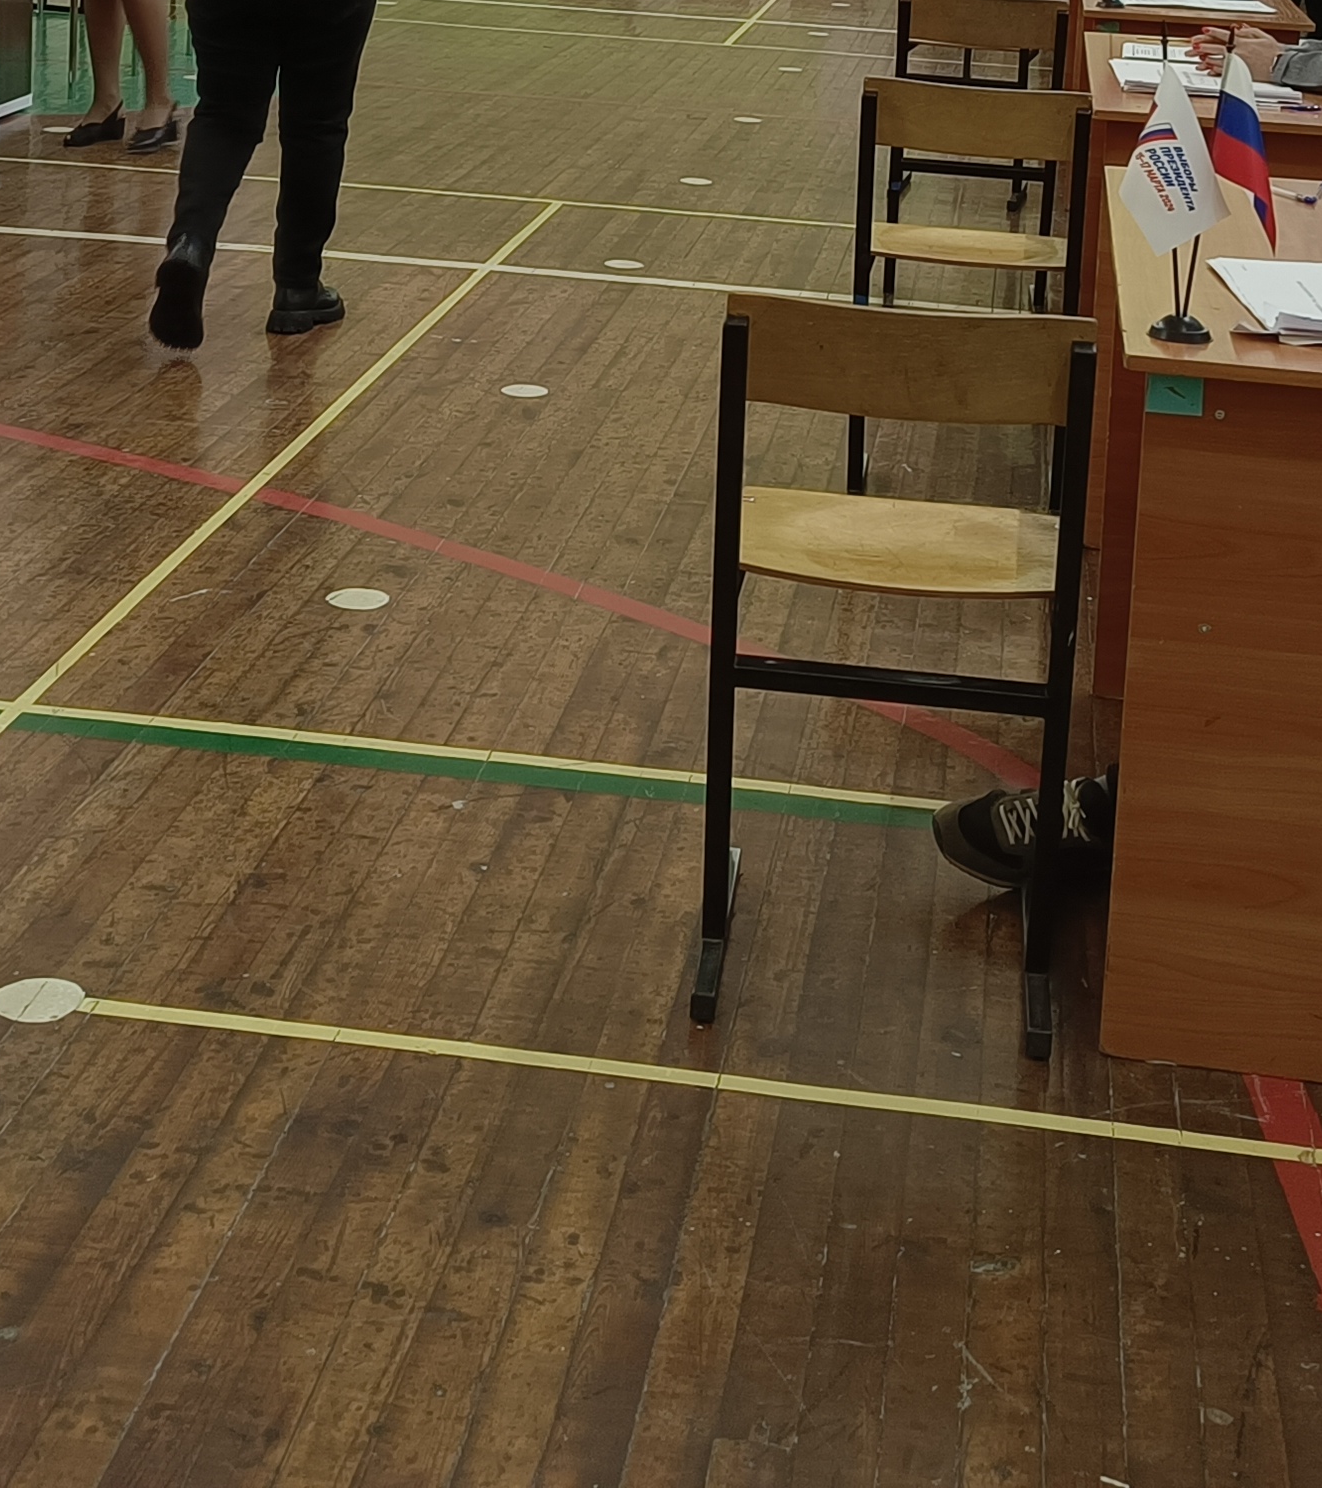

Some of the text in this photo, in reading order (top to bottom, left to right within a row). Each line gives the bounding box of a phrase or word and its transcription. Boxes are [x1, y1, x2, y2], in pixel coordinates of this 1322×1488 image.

[1144, 168, 1166, 193] МАРТА
[1145, 148, 1175, 187] РОССИИ
[1159, 146, 1195, 211] ПРЕЗИДЕНТА
[1173, 146, 1198, 192] ВЫБОРЫ
